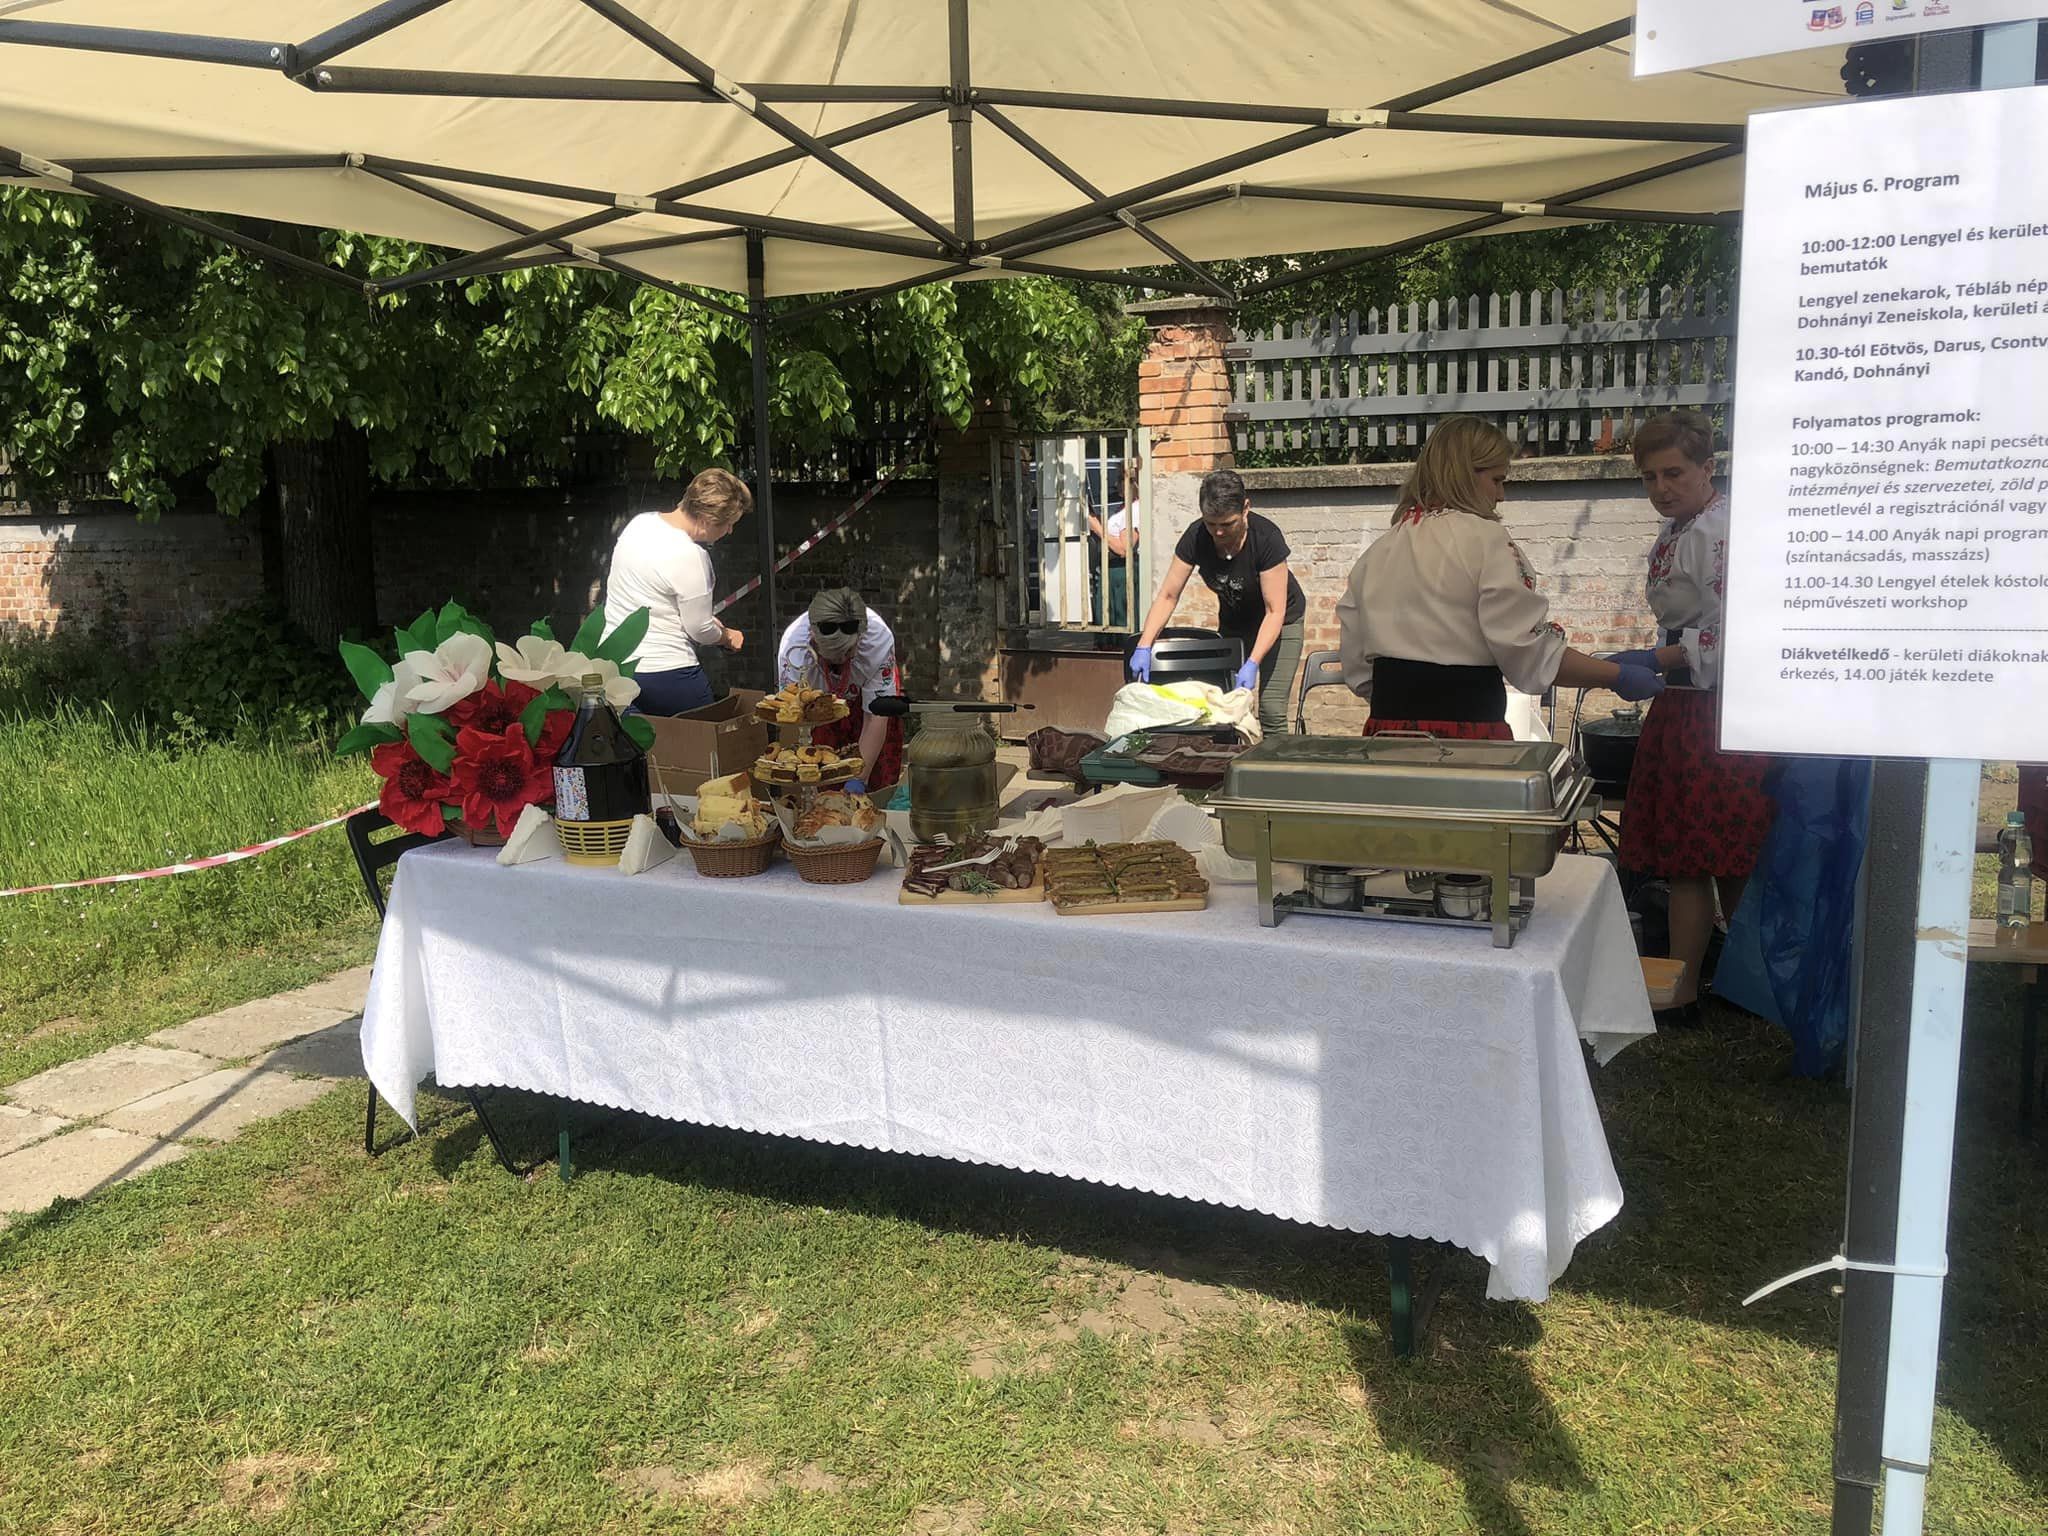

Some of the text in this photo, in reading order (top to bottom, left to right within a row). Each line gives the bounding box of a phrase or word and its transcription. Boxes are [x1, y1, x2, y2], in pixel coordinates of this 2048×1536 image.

[1805, 174, 1960, 199] Május 6. Program
[1802, 235, 1896, 254] 10:00-12:00
[1900, 228, 1962, 247] Lengyel
[1966, 227, 1984, 241] és
[1800, 256, 1888, 275] bemutatók
[1799, 291, 1858, 309] Lengyel
[1862, 286, 1951, 303] zenekarok,
[1955, 281, 2011, 297] Tébláb
[1798, 312, 1873, 329] Dohnányi
[1876, 305, 1968, 324] Zeneiskola,
[1973, 301, 2038, 317] kerületi
[1796, 344, 1865, 361] 10.30-tól
[1870, 341, 1928, 356] Eötvös,
[1934, 340, 1986, 352] Darus,
[1795, 362, 1930, 382] Kandó, Dohnányi
[1793, 409, 1981, 431] Folyamatos programok:
[1792, 442, 1833, 456] 10:00
[1851, 440, 1894, 453] 14:30
[1897, 437, 1947, 454] Anyák
[1952, 437, 1986, 452] napi
[1790, 459, 1929, 477] nagyközönségnek:
[1788, 482, 1881, 497] intézményei
[1883, 481, 1901, 494] és
[1904, 479, 1995, 493] szervezetei,
[2000, 477, 2035, 491] zöld
[1788, 499, 2047, 517] menetlevél a regisztrációnál vagy
[1788, 530, 1829, 543] 10:00
[1846, 529, 1888, 542] 14.00
[1892, 528, 1940, 544] Anyák
[1945, 528, 1979, 542] napi
[1786, 547, 1989, 565] (színtanácsadás, masszázs)
[1785, 576, 1873, 589] 11.00-14.30
[1878, 575, 1935, 591] Lengyel
[1940, 574, 1989, 587] ételek
[1784, 595, 1968, 611] népművészeti workshop
[1781, 648, 1890, 660] Diákvetélkedő
[1904, 648, 1963, 661] kerületi
[1780, 667, 1994, 683] érkezés, 14.00 játék kezdete
